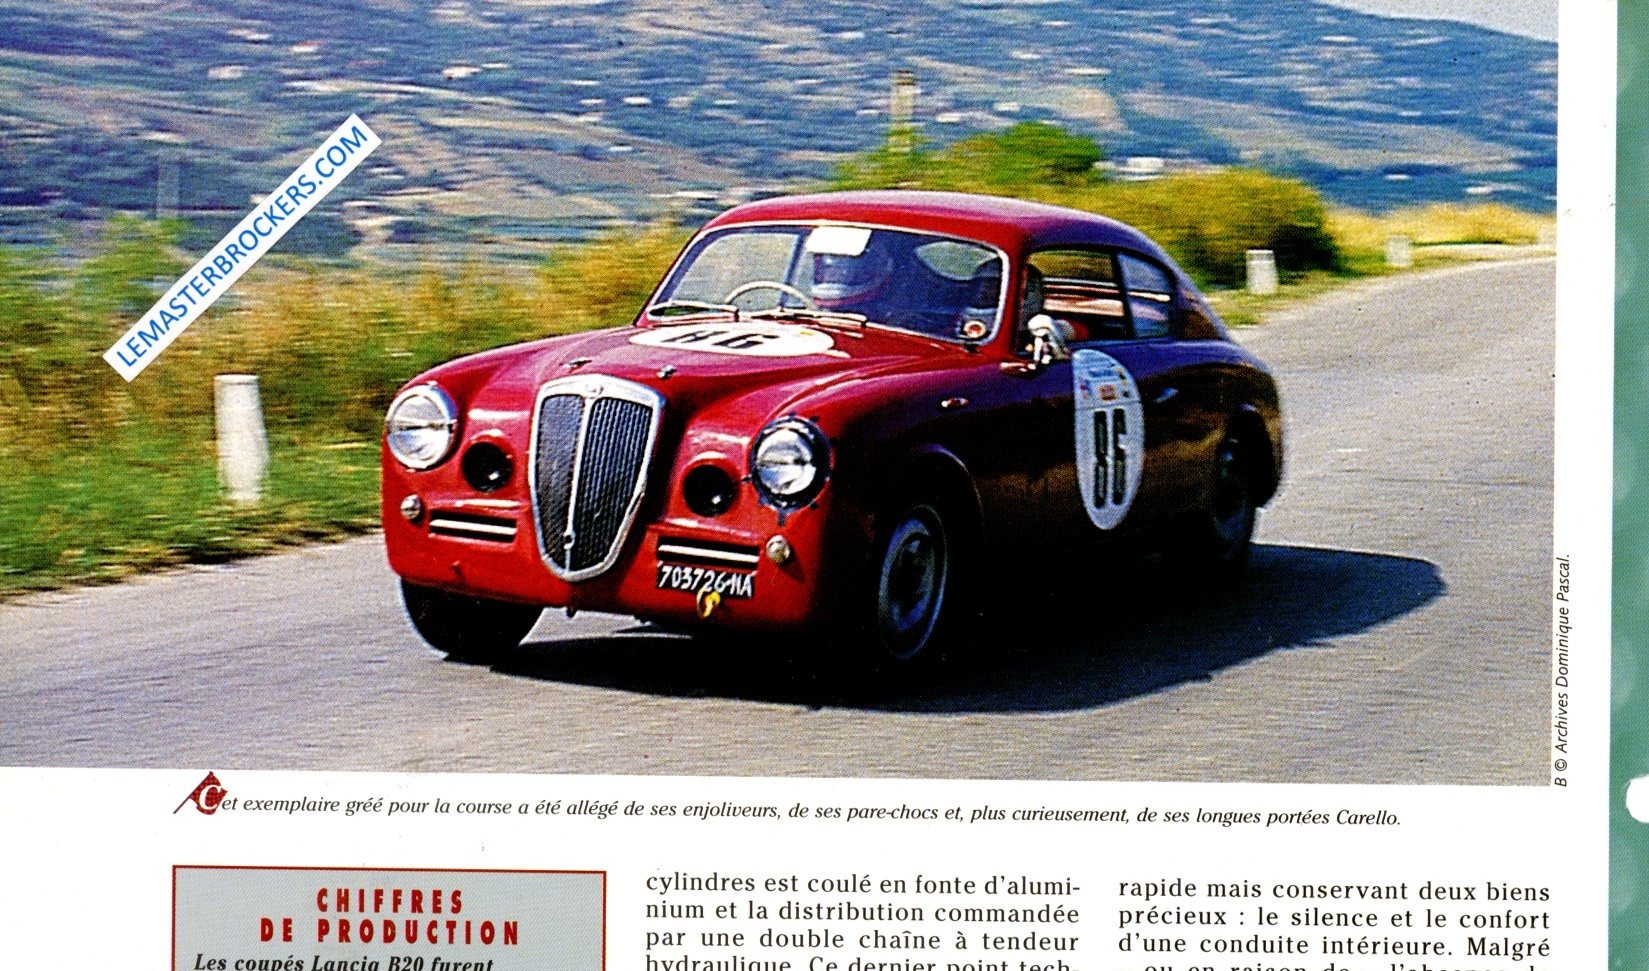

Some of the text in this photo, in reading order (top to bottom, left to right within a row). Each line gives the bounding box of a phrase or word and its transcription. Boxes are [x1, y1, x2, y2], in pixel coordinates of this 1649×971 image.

[1093, 408, 1128, 509] 86
[1555, 553, 1570, 602] Pascal.
[1555, 606, 1573, 688] Dominique
[1554, 691, 1569, 754] Archives
[1554, 776, 1568, 788] B
[243, 796, 340, 815] exemplaire
[345, 797, 384, 817] gréé
[387, 801, 430, 816] pour
[434, 798, 451, 814] la
[456, 802, 513, 814] course
[518, 803, 529, 815] a
[534, 799, 562, 815] été
[566, 800, 619, 820] allégé
[623, 800, 645, 816] de
[649, 805, 677, 816] ses
[682, 801, 781, 821] enjoliveurs,
[788, 802, 809, 818] de
[814, 807, 842, 819] ses
[846, 804, 939, 822] pare-chocs
[944, 806, 964, 823] et,
[970, 805, 1006, 824] plus
[1012, 806, 1129, 824] curieusement,
[1136, 807, 1158, 823] de
[1163, 811, 1190, 823] ses
[1196, 807, 1261, 828] longues
[1266, 809, 1330, 828] portées
[1336, 809, 1401, 825] Carello.
[646, 871, 755, 894] cylindres
[764, 875, 799, 892] est
[807, 873, 871, 893] coulé
[879, 879, 906, 894] en
[915, 874, 976, 895] fonte
[1119, 877, 1550, 902] rapide mais conservant deux biens
[317, 888, 461, 913] CHIFFRES
[646, 900, 1079, 924] nium et la distribution commandée
[1119, 905, 1227, 929] précieux
[1258, 906, 1279, 926] le
[1291, 907, 1378, 927] silence
[1390, 910, 1413, 928] et
[1426, 908, 1447, 928] le
[1459, 909, 1550, 929] confort
[260, 917, 517, 945] DE PRODUCTION
[646, 928, 1079, 951] par une double chaîne à tendeur
[1200, 934, 1309, 954] conduite
[1322, 935, 1452, 956] intérieure.
[1467, 937, 1550, 961] Malgré
[194, 953, 494, 971] Les coupés Lancia B20 furent
